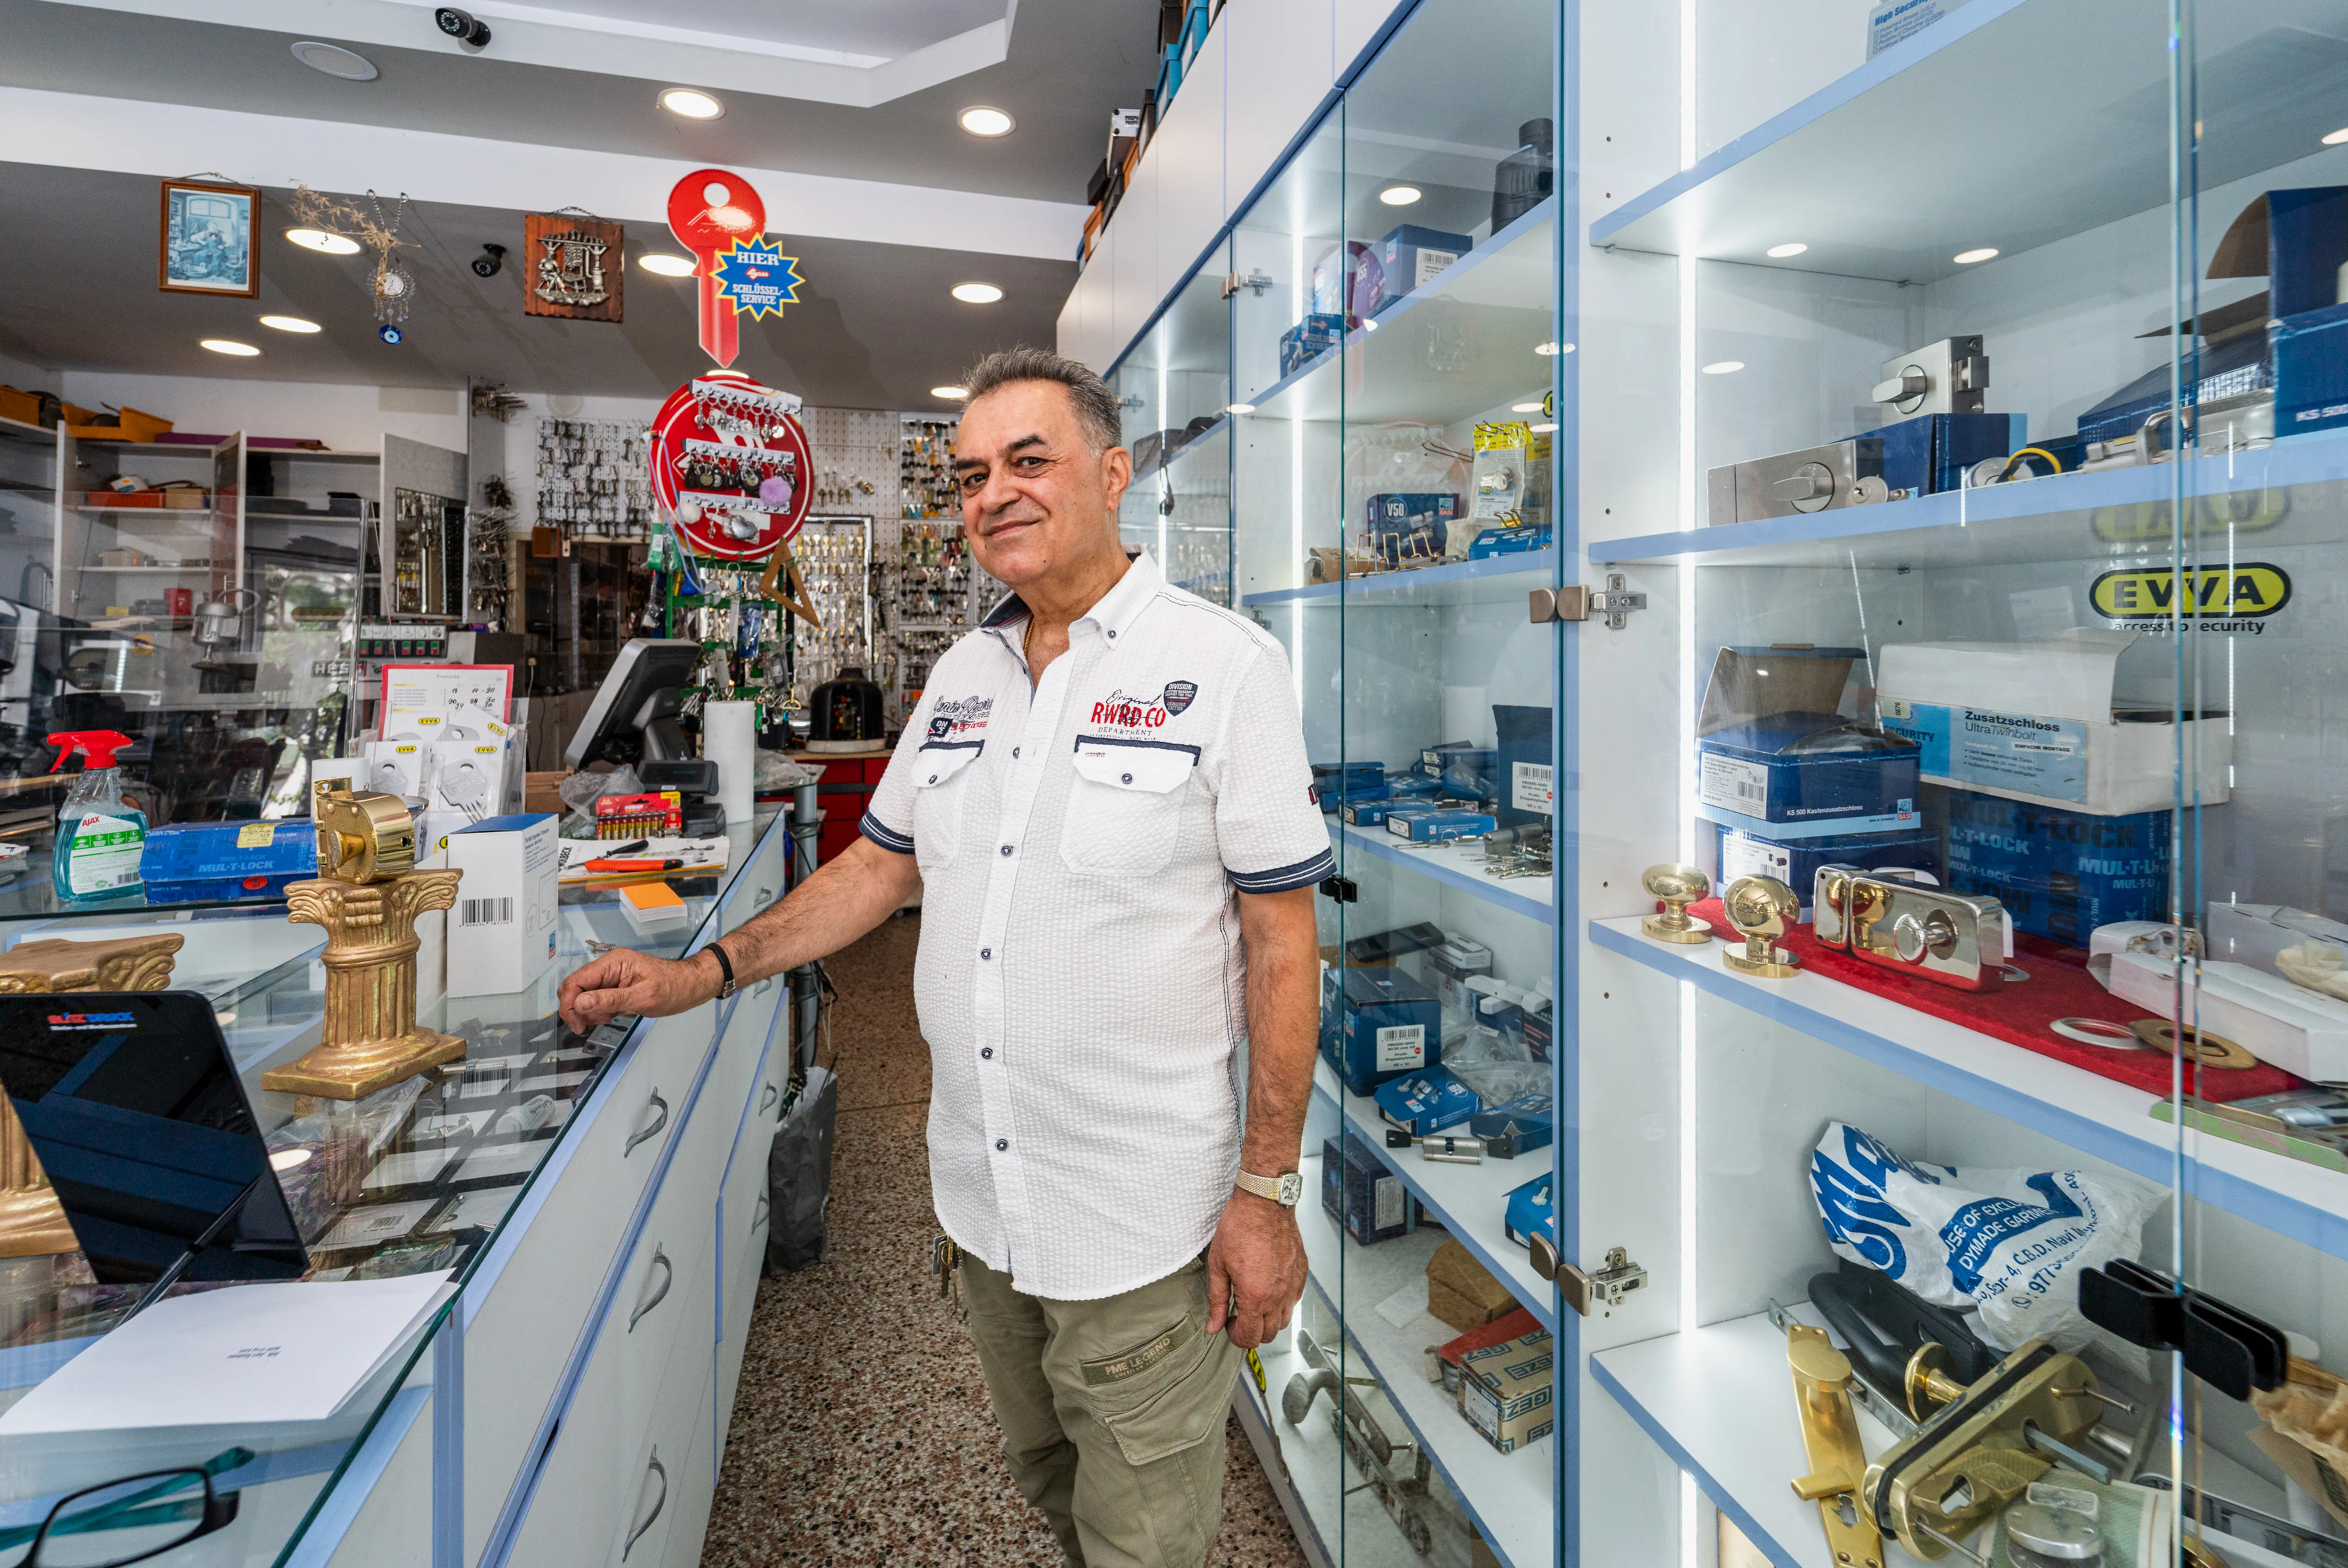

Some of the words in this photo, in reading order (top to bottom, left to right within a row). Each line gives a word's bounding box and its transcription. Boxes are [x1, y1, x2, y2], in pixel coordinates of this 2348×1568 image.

[1875, 11, 1893, 26] High
[1894, 0, 1928, 16] Securi
[737, 251, 779, 266] HIER
[732, 283, 784, 296] SCHLÜSSEL-
[741, 293, 776, 305] SERVICE
[1387, 503, 1404, 517] V50
[2114, 575, 2265, 608] EVVA
[2193, 618, 2265, 635] ecurity
[1106, 689, 1162, 707] Original
[1090, 702, 1166, 728] RWRD.CO
[1965, 711, 2060, 732] Zusatzschloss
[1098, 727, 1152, 736] DEPARTMENT
[1965, 722, 2036, 741] UltraTwinbolt
[1807, 805, 1863, 814] Kastenzusatzschloss
[82, 816, 100, 826] AJAX
[1949, 825, 2030, 855] L-T-LOCK
[198, 861, 274, 873] MUL-T-LOCK
[1984, 1199, 2026, 1215] EXCLU
[2013, 1243, 2052, 1265] C.B.D.
[2045, 1227, 2077, 1249] Navi
[1105, 1362, 1128, 1375] PME
[1130, 1338, 1171, 1368] LEGEND
[1505, 1389, 1547, 1420] GEZ
